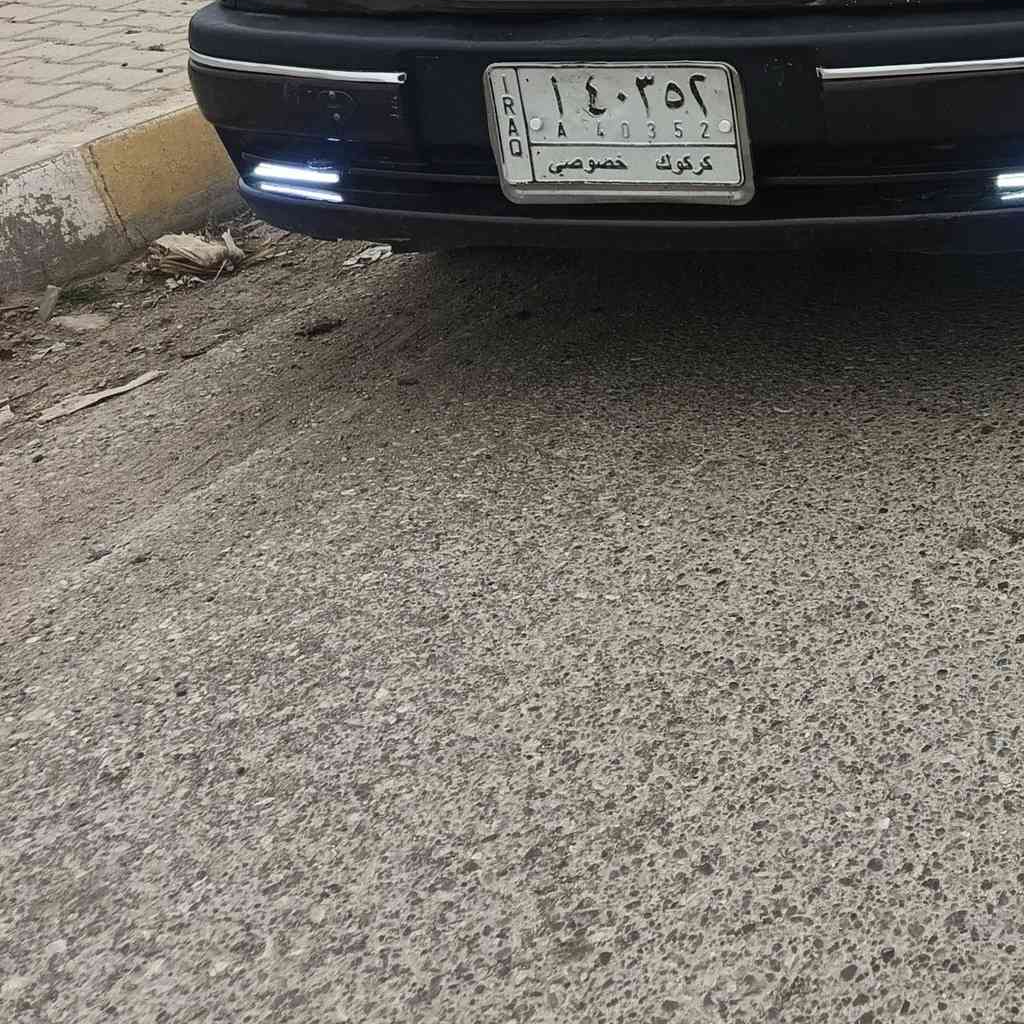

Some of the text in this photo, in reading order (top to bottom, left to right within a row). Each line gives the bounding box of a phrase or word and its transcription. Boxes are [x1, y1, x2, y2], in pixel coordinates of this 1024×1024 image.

[501, 74, 523, 158] IRAQ
[548, 153, 713, 176] كركوك خصوصي
